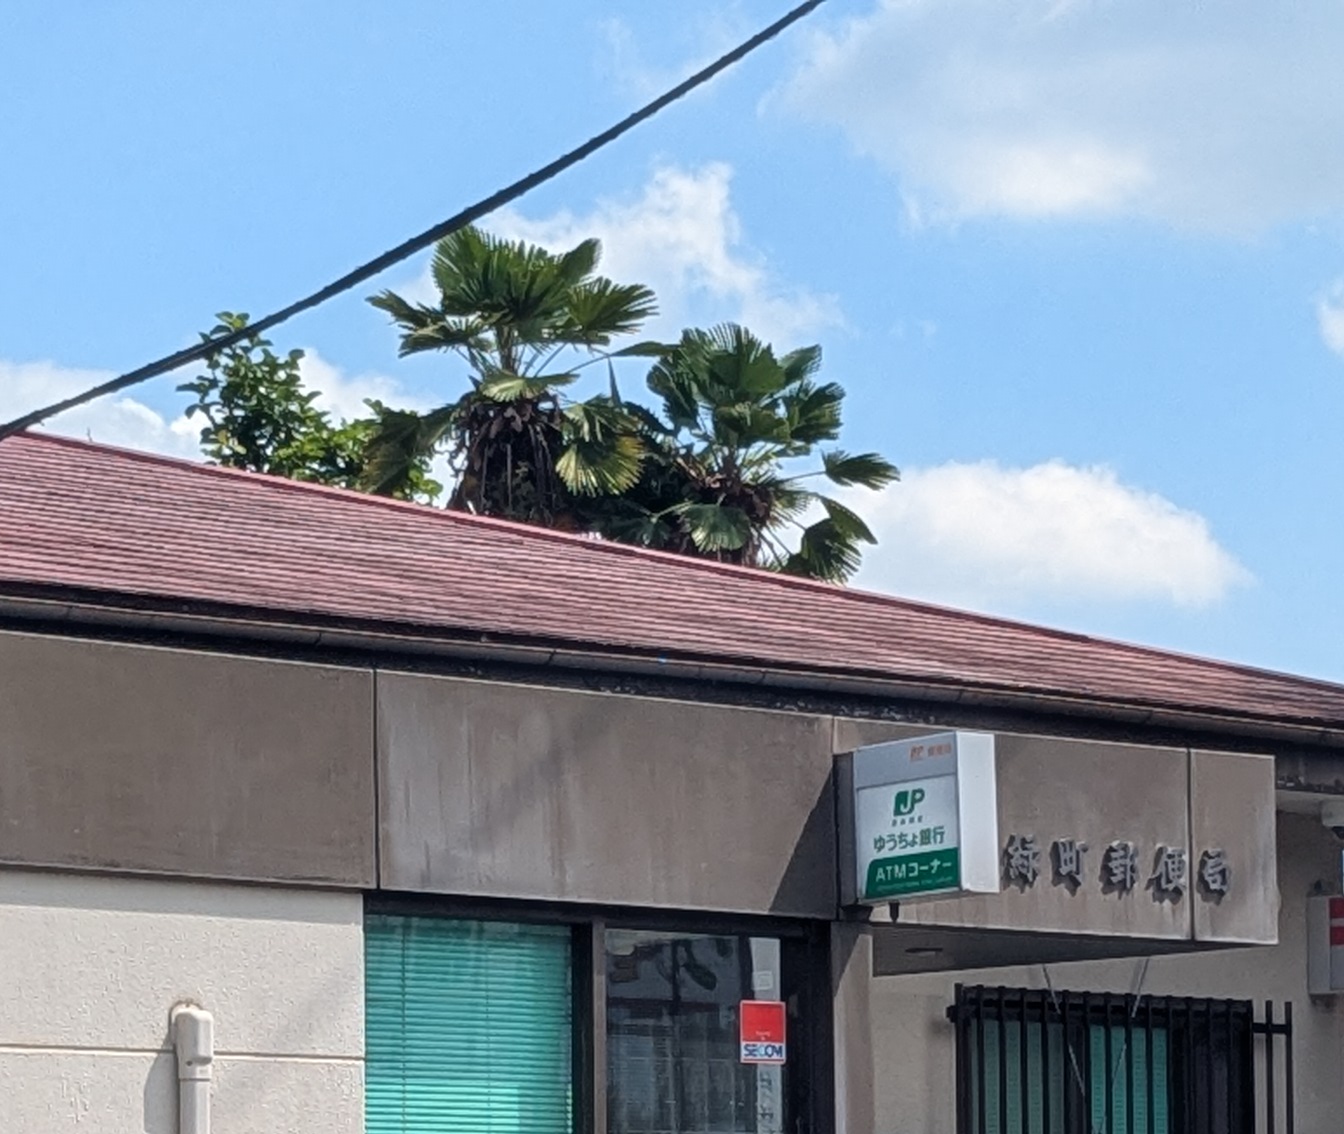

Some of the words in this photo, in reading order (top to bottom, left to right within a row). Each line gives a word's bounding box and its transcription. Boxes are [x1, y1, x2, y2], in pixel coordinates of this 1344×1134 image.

[893, 787, 925, 817] JP
[873, 826, 946, 853] ゆうちょ銀行
[876, 858, 952, 883] ATMコーナー
[743, 1043, 783, 1058] SECOM
